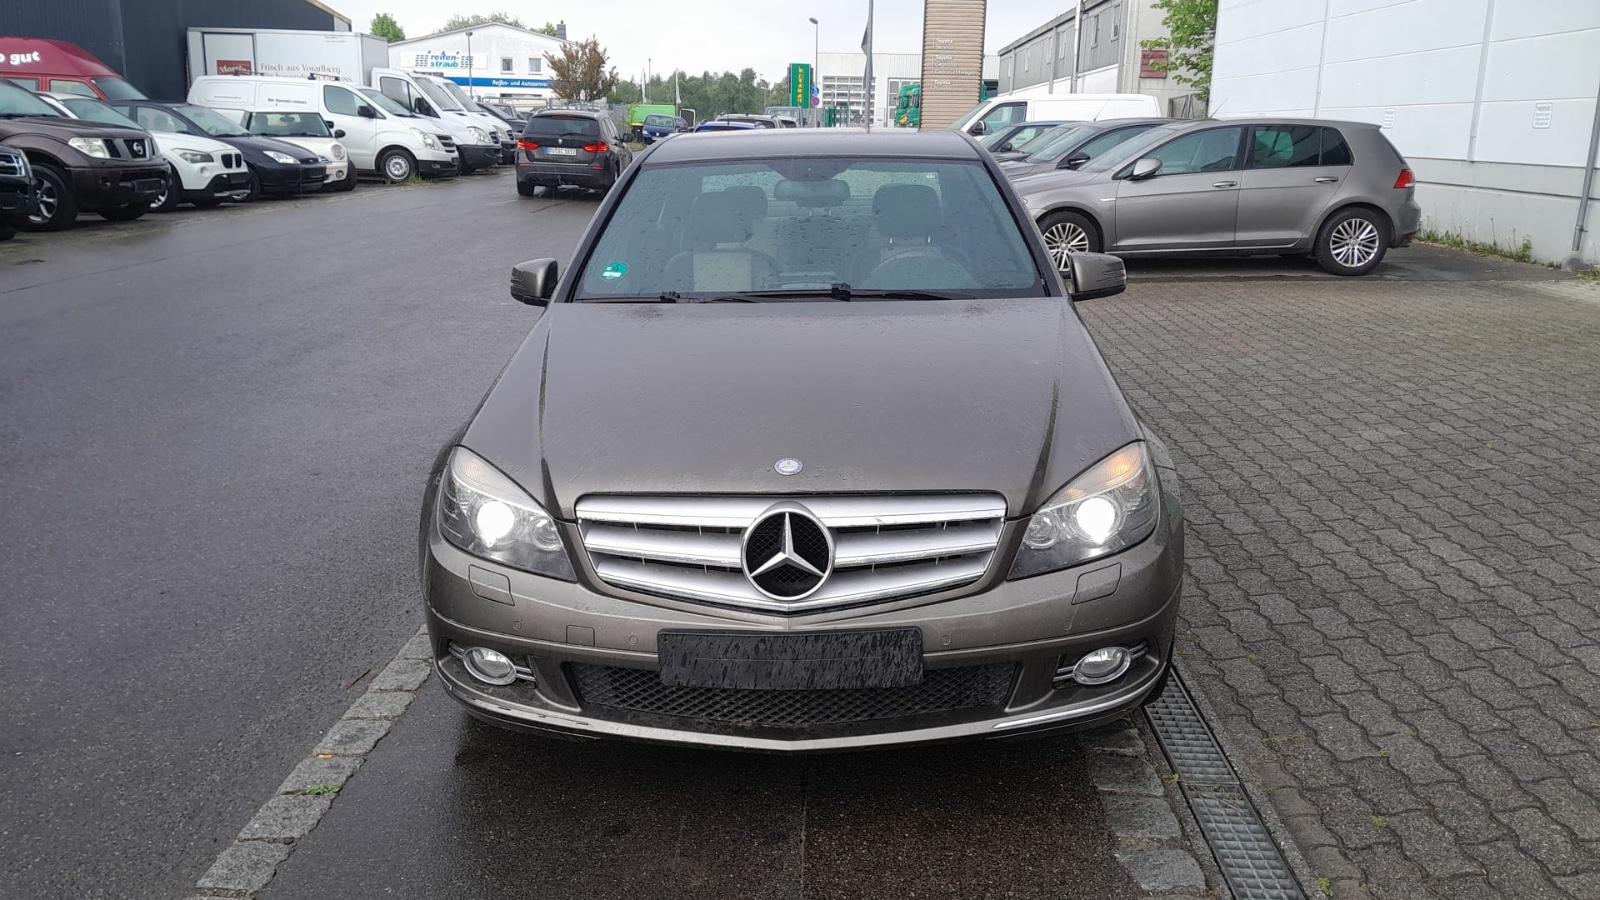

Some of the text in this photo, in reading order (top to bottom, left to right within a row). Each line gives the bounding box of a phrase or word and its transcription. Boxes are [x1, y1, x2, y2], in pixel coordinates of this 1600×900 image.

[9, 51, 40, 65] gut
[260, 63, 283, 71] Frisch
[301, 64, 341, 75] Vorarlberg
